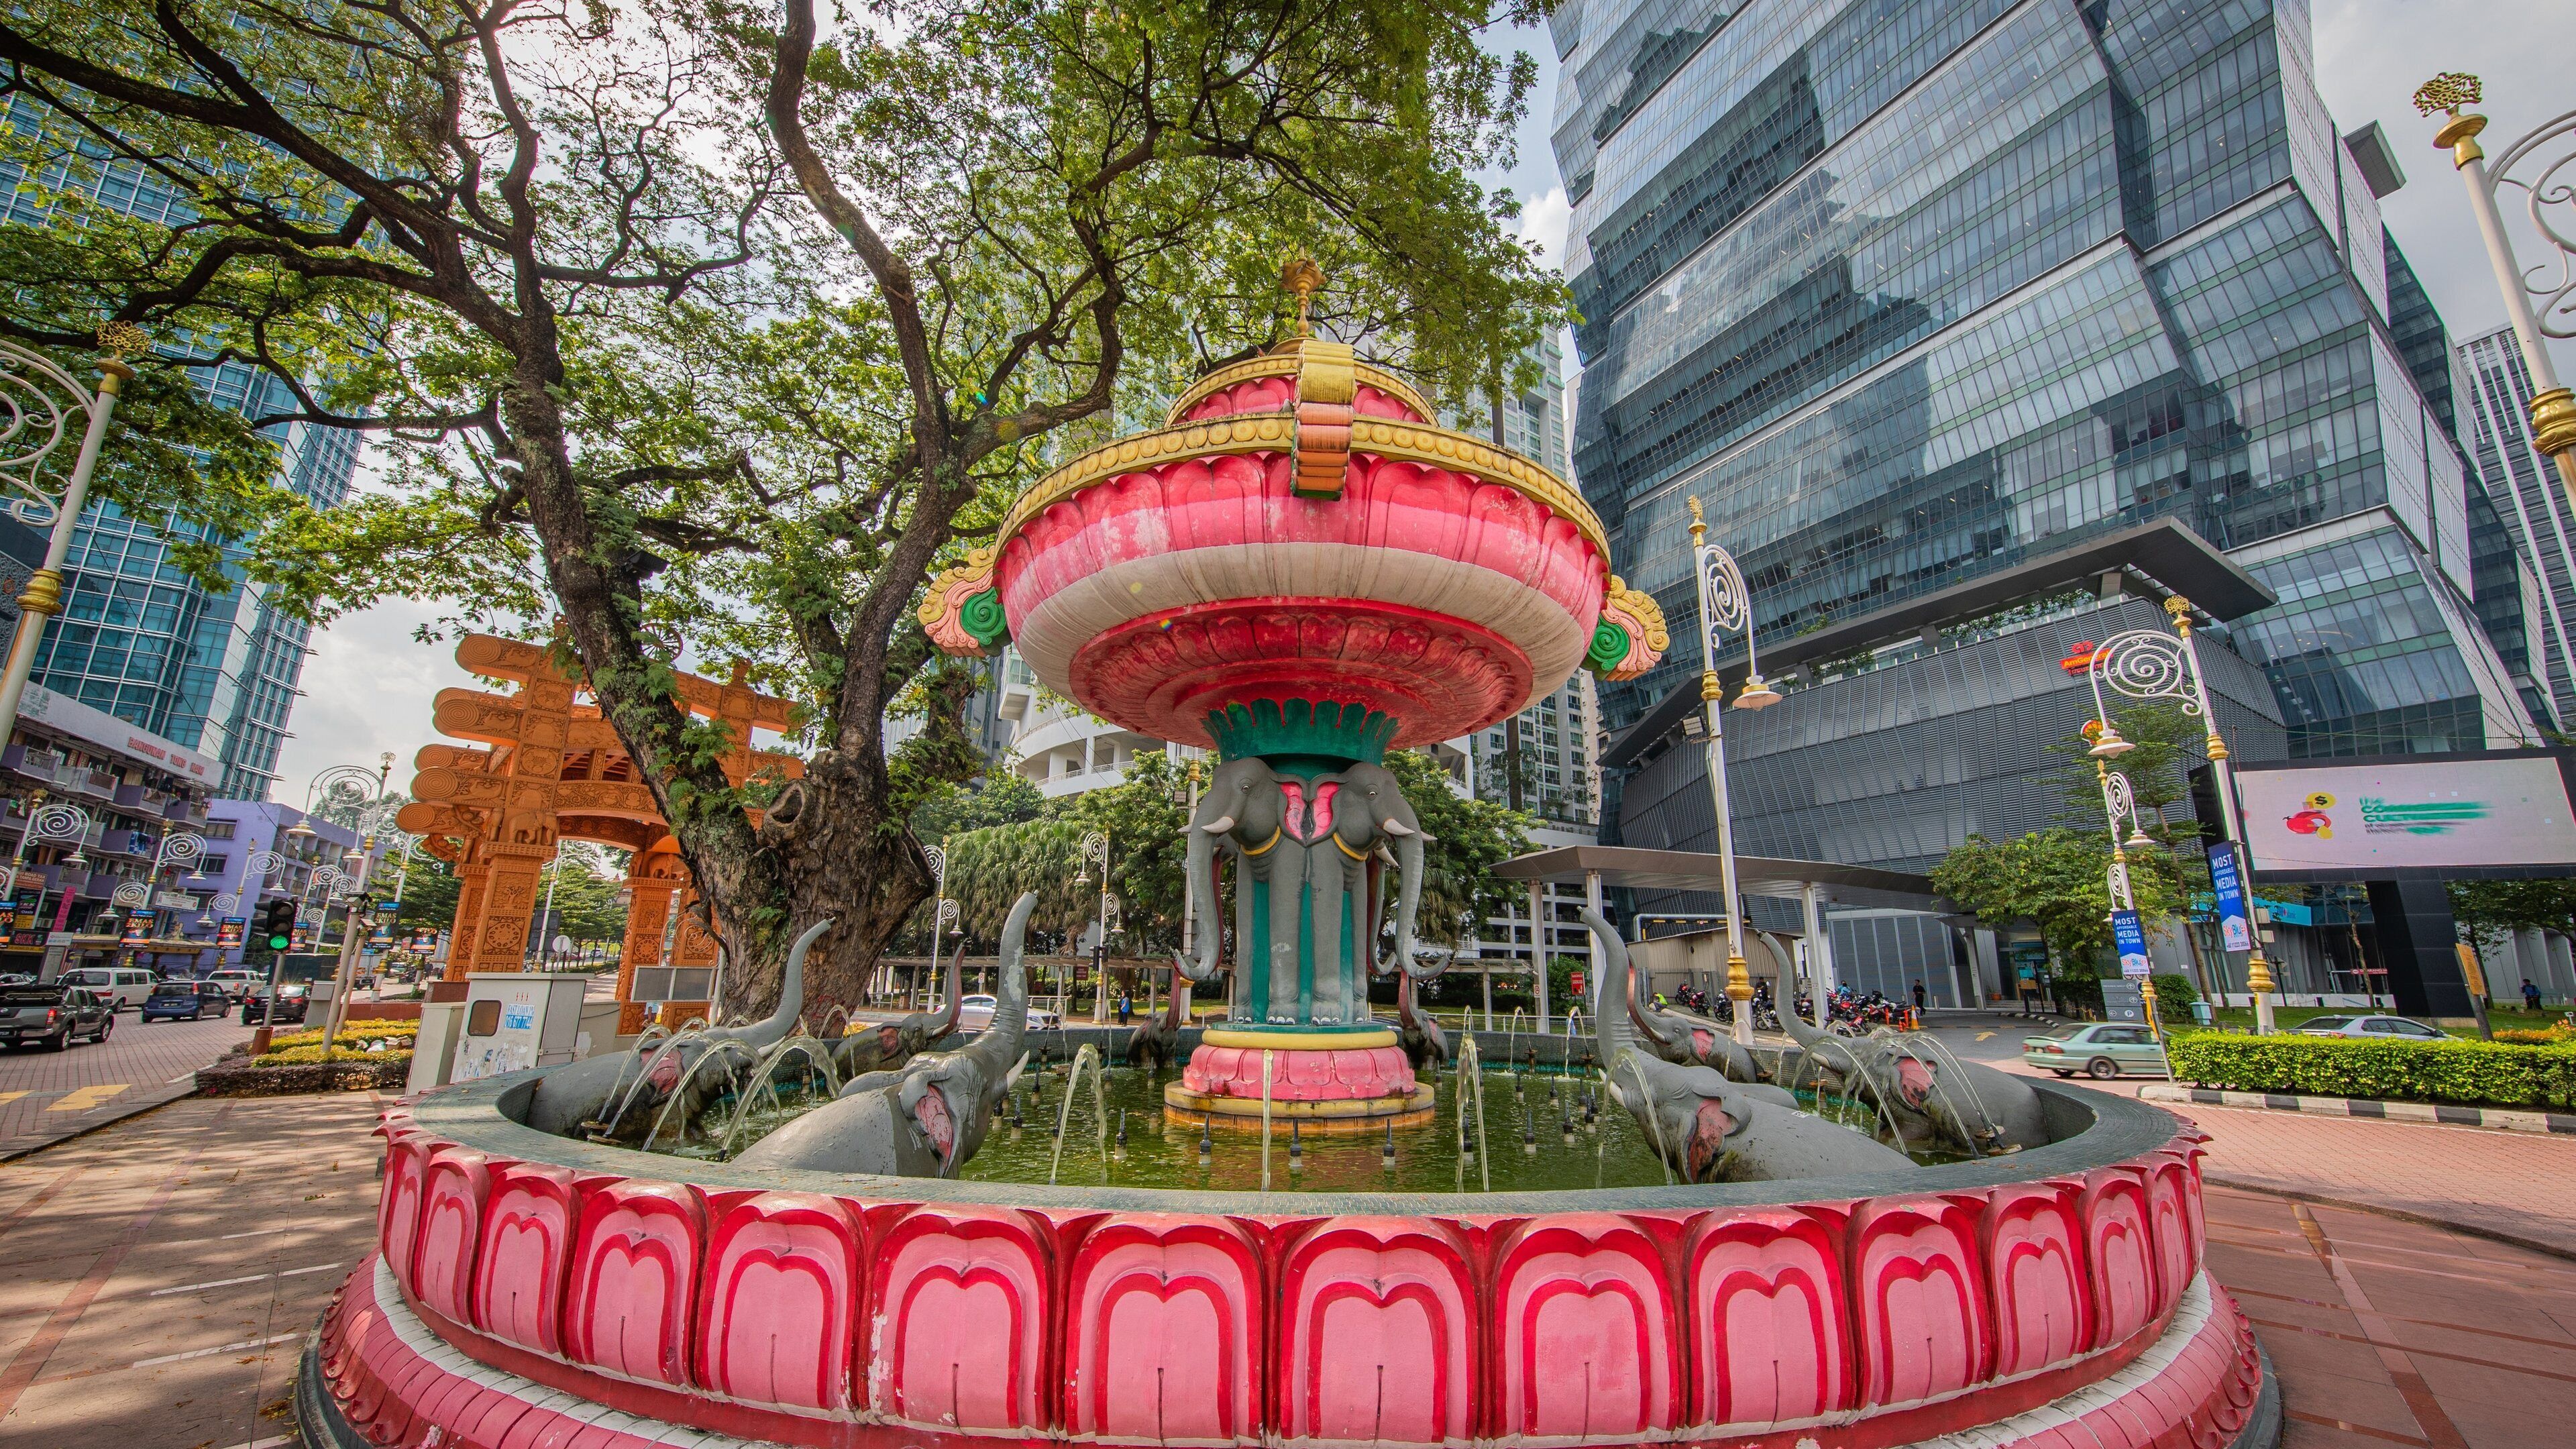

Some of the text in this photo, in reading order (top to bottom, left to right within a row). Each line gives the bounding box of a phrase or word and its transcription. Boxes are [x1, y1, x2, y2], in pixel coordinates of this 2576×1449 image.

[127, 737, 167, 760] BANGUNAN
[2212, 853, 2232, 869] MOST
[2214, 866, 2235, 876] AFFORDABLE
[2216, 875, 2237, 890] MEDIA
[2218, 888, 2239, 901] IN TOWN
[2114, 916, 2136, 925] MOST
[2117, 930, 2139, 938] MEDIA
[508, 1005, 517, 1014] FAST
[517, 1006, 529, 1015] LOAN
